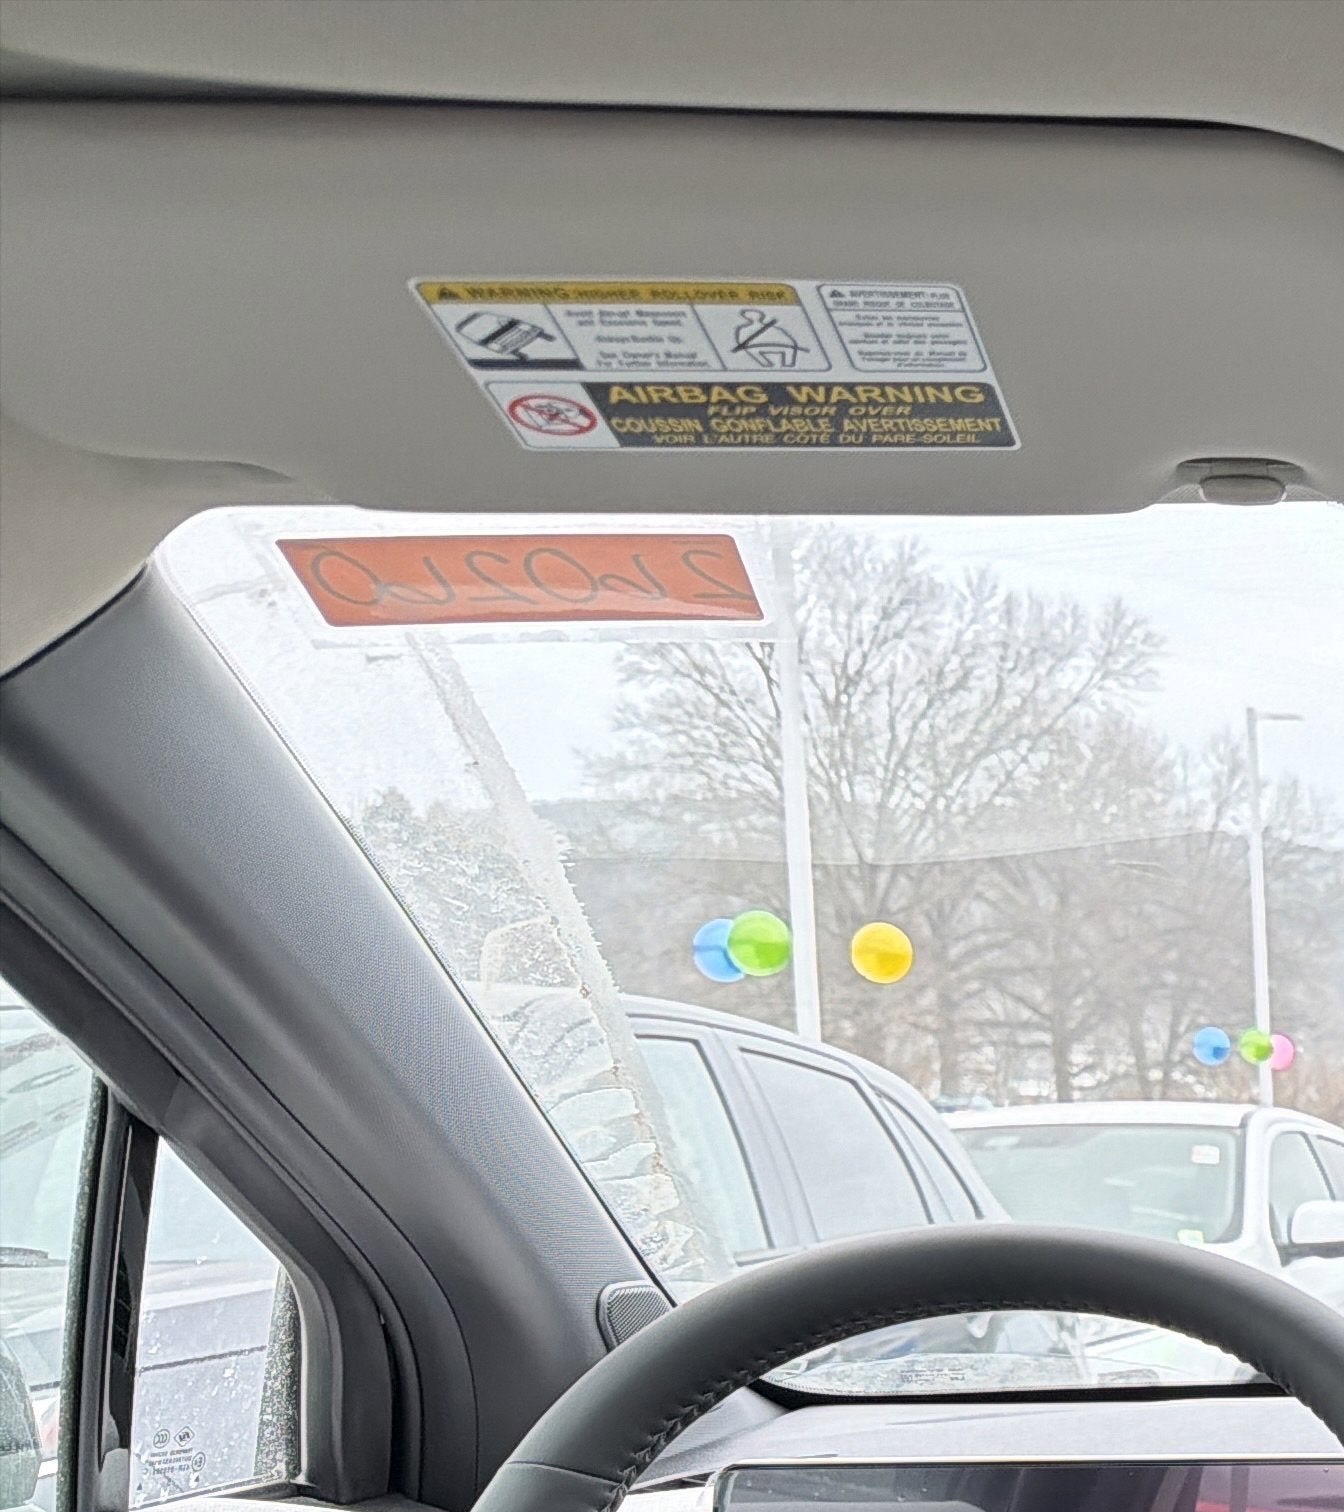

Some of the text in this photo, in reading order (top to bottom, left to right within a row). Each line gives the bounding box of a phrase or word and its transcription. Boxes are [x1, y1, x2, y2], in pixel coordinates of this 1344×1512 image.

[609, 385, 985, 404] AIRBAG WARNING
[707, 405, 911, 416] FLIP VISOR OVER
[610, 417, 1000, 433] COUSSIN GONFLABLE AVERTISSEMENT
[704, 434, 774, 444] L'AUTRE
[839, 434, 863, 443] DU
